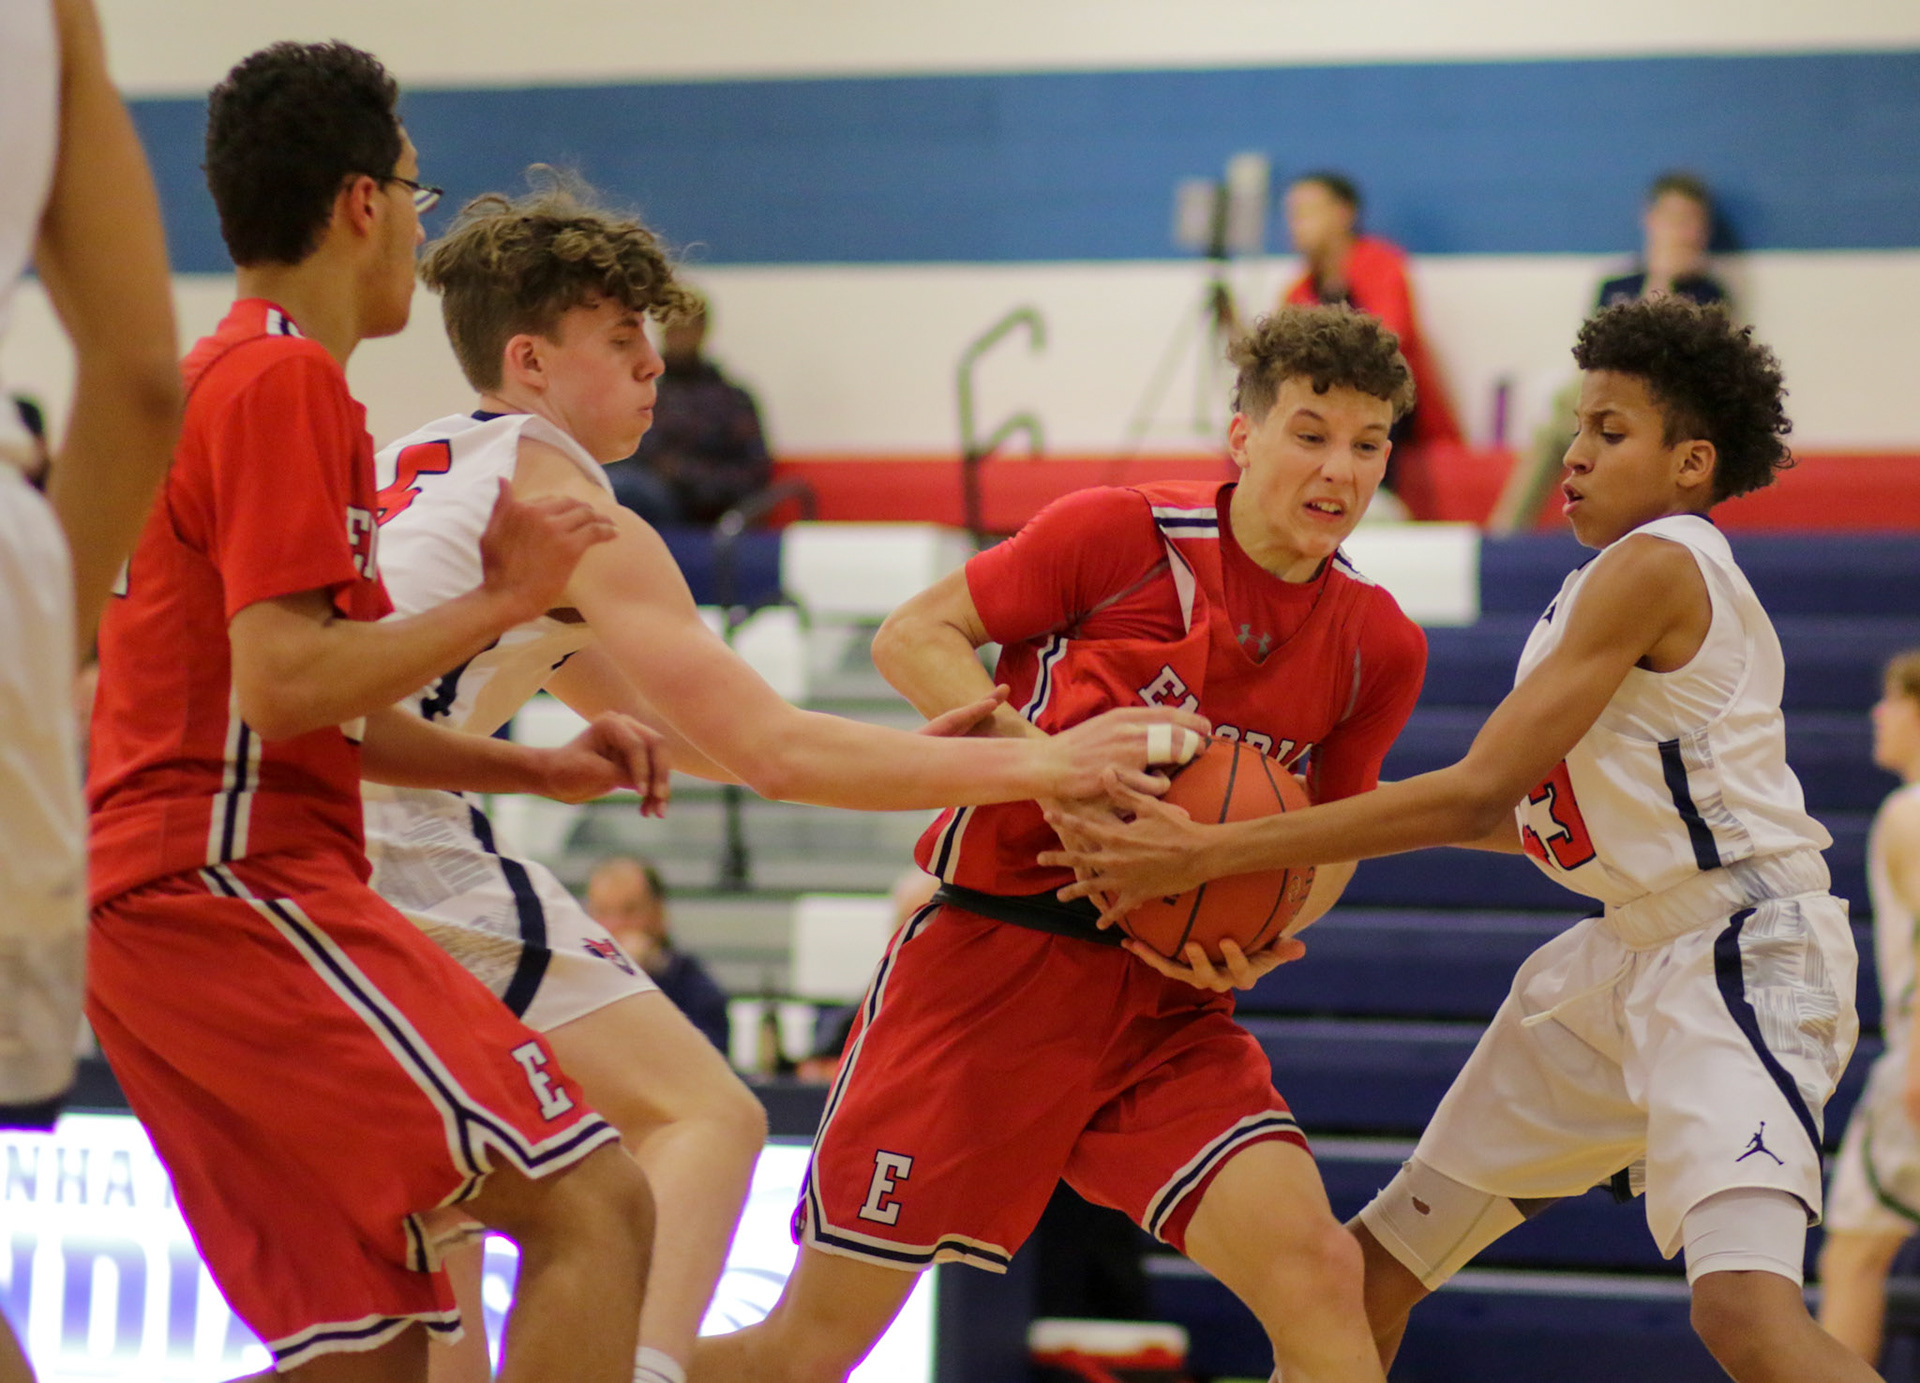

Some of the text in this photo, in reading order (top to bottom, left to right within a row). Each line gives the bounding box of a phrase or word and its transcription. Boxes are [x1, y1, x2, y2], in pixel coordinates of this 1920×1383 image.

[1522, 758, 1597, 871] 3
[511, 1040, 575, 1122] E
[5, 1144, 174, 1208] NHA
[858, 1149, 914, 1227] E
